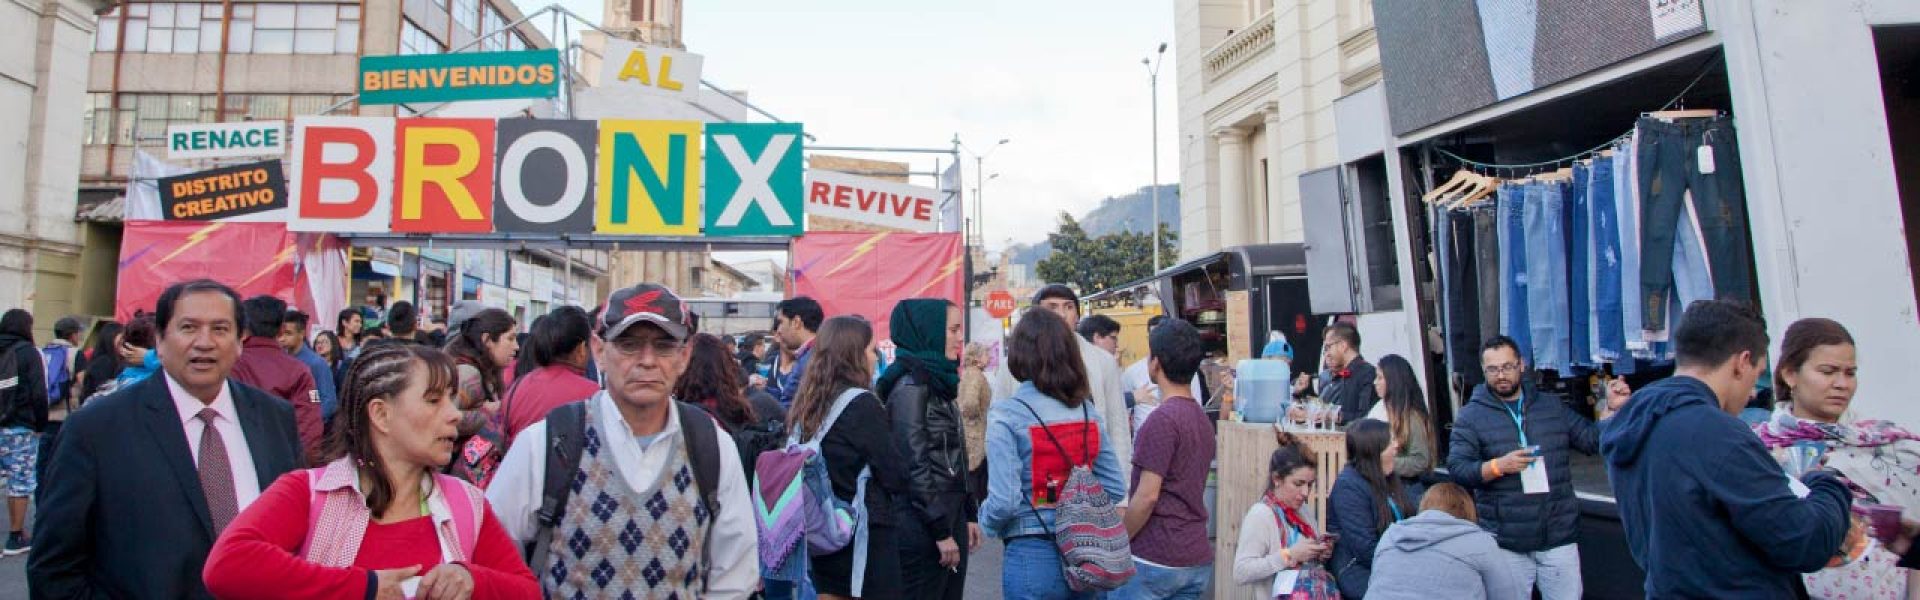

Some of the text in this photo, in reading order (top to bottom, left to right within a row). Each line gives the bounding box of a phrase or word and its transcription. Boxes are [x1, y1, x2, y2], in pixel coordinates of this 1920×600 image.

[363, 64, 555, 91] BIENVENIDOS
[618, 48, 685, 91] AL
[172, 129, 279, 151] RENACE
[172, 168, 268, 198] DISTRITO
[299, 125, 796, 227] BRONX
[173, 188, 274, 219] CREATIVO
[810, 181, 934, 221] REVIVE
